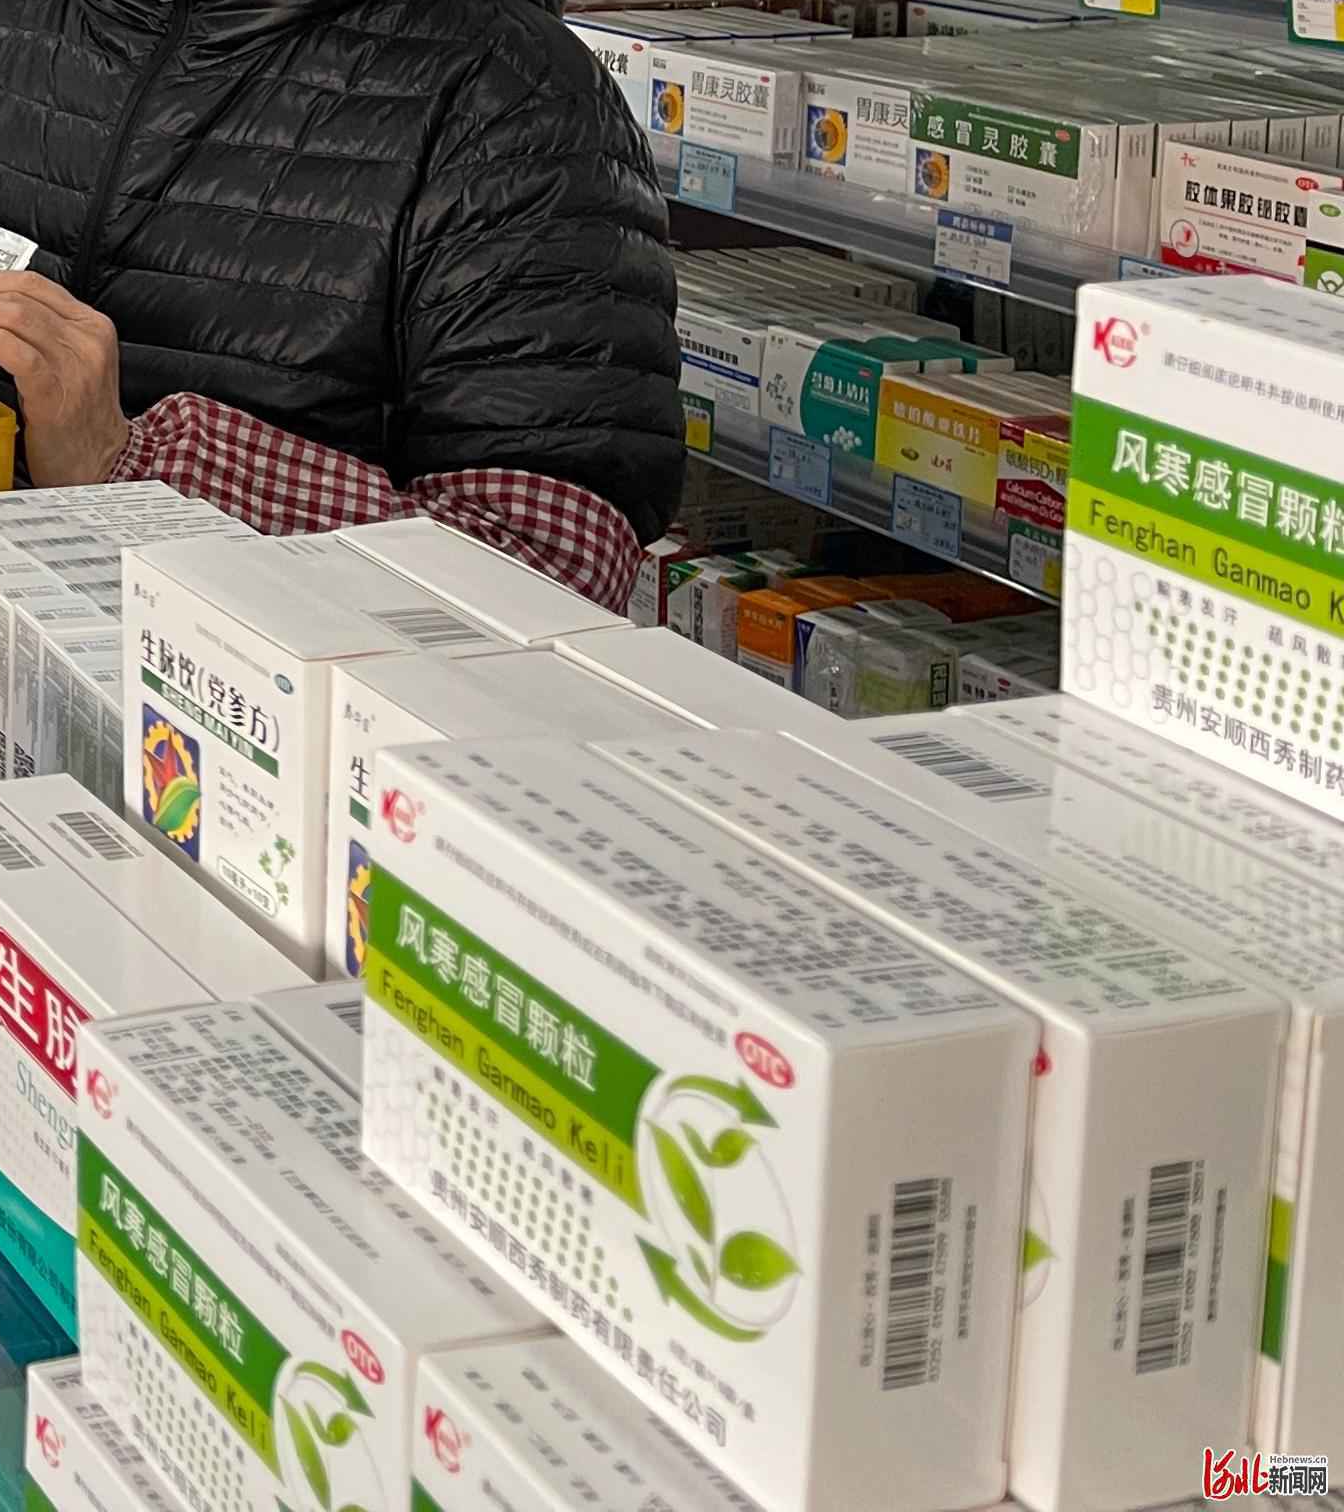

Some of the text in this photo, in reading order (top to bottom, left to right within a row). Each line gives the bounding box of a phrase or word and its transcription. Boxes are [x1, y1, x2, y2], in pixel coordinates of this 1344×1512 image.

[691, 71, 769, 110] 胃康灵胶囊
[926, 115, 1058, 170] 感冒灵胶囊
[1089, 498, 1198, 567] Fenghan
[1214, 546, 1311, 610] Ganmao
[396, 903, 597, 1092] 风寒感冒颗粒
[381, 968, 624, 1187] Fenghan Ganmao Keli
[741, 1037, 791, 1087] OTC
[98, 1172, 244, 1365] 风寒感冒颗粒
[88, 1228, 269, 1453] Fenghan Ganmao Keli
[343, 1334, 382, 1381] OTC
